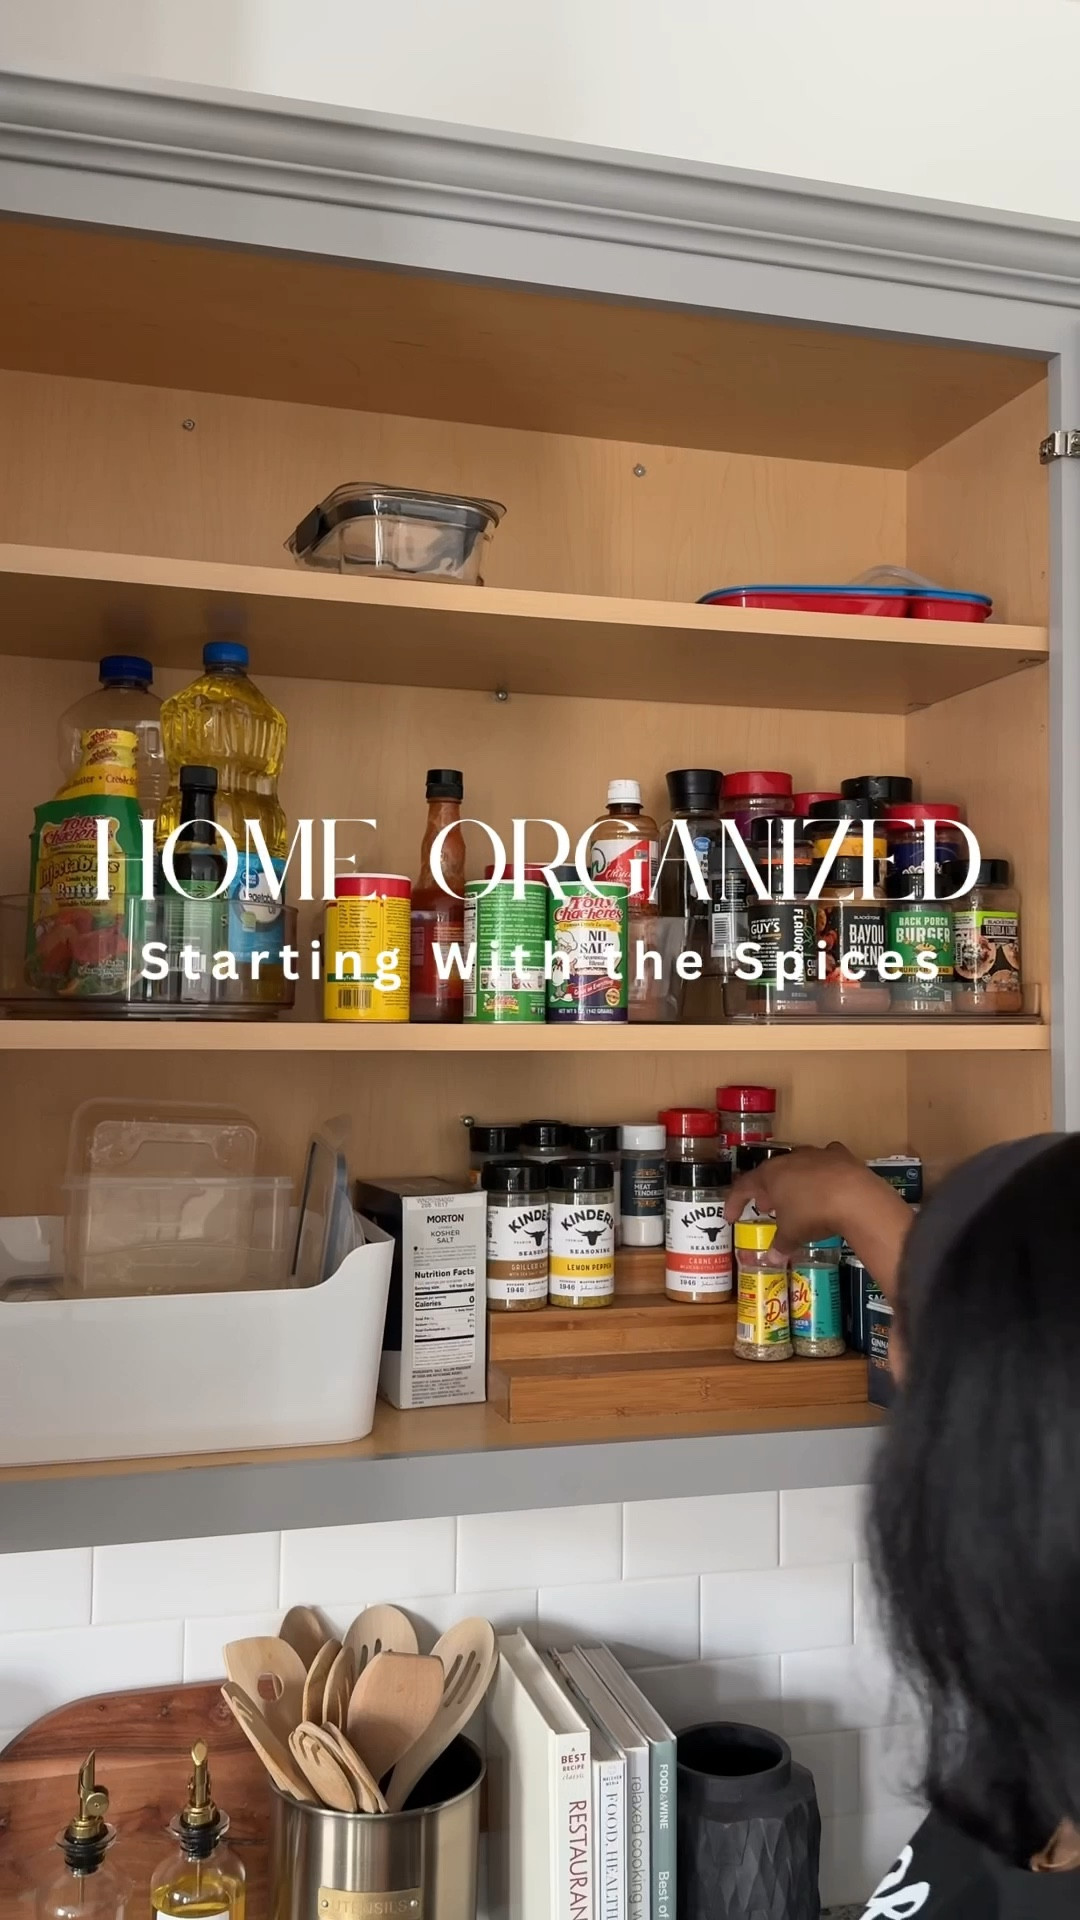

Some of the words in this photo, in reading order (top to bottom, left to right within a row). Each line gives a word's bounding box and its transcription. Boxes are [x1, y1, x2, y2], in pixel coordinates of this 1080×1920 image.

[40, 853, 121, 890] Injectabls
[899, 917, 922, 926] BACK
[925, 916, 949, 926] PORCH
[750, 921, 781, 935] GUY'S
[849, 924, 885, 944] BAYOU
[588, 930, 608, 942] NO
[895, 927, 951, 943] BURGER
[426, 1213, 465, 1224] MORTON
[508, 1209, 549, 1234] KINDE
[681, 1206, 724, 1228] KINDE
[430, 1229, 460, 1237] KOSHER
[570, 1247, 611, 1255] SEASONING
[567, 1263, 589, 1271] LEMON
[592, 1262, 612, 1270] PEPPER
[414, 1270, 451, 1279] Nutrition
[453, 1268, 475, 1277] Facts
[469, 1295, 475, 1304] 0
[868, 1293, 885, 1301] SAG
[765, 1298, 788, 1323] Da
[561, 1752, 587, 1764] BEST
[562, 1764, 585, 1772] RECIPE
[562, 1771, 585, 1780] classic
[631, 1776, 645, 1835] relaxed
[629, 1837, 647, 1904] cooking
[658, 1871, 670, 1901] Best
[658, 1906, 670, 1918] of
